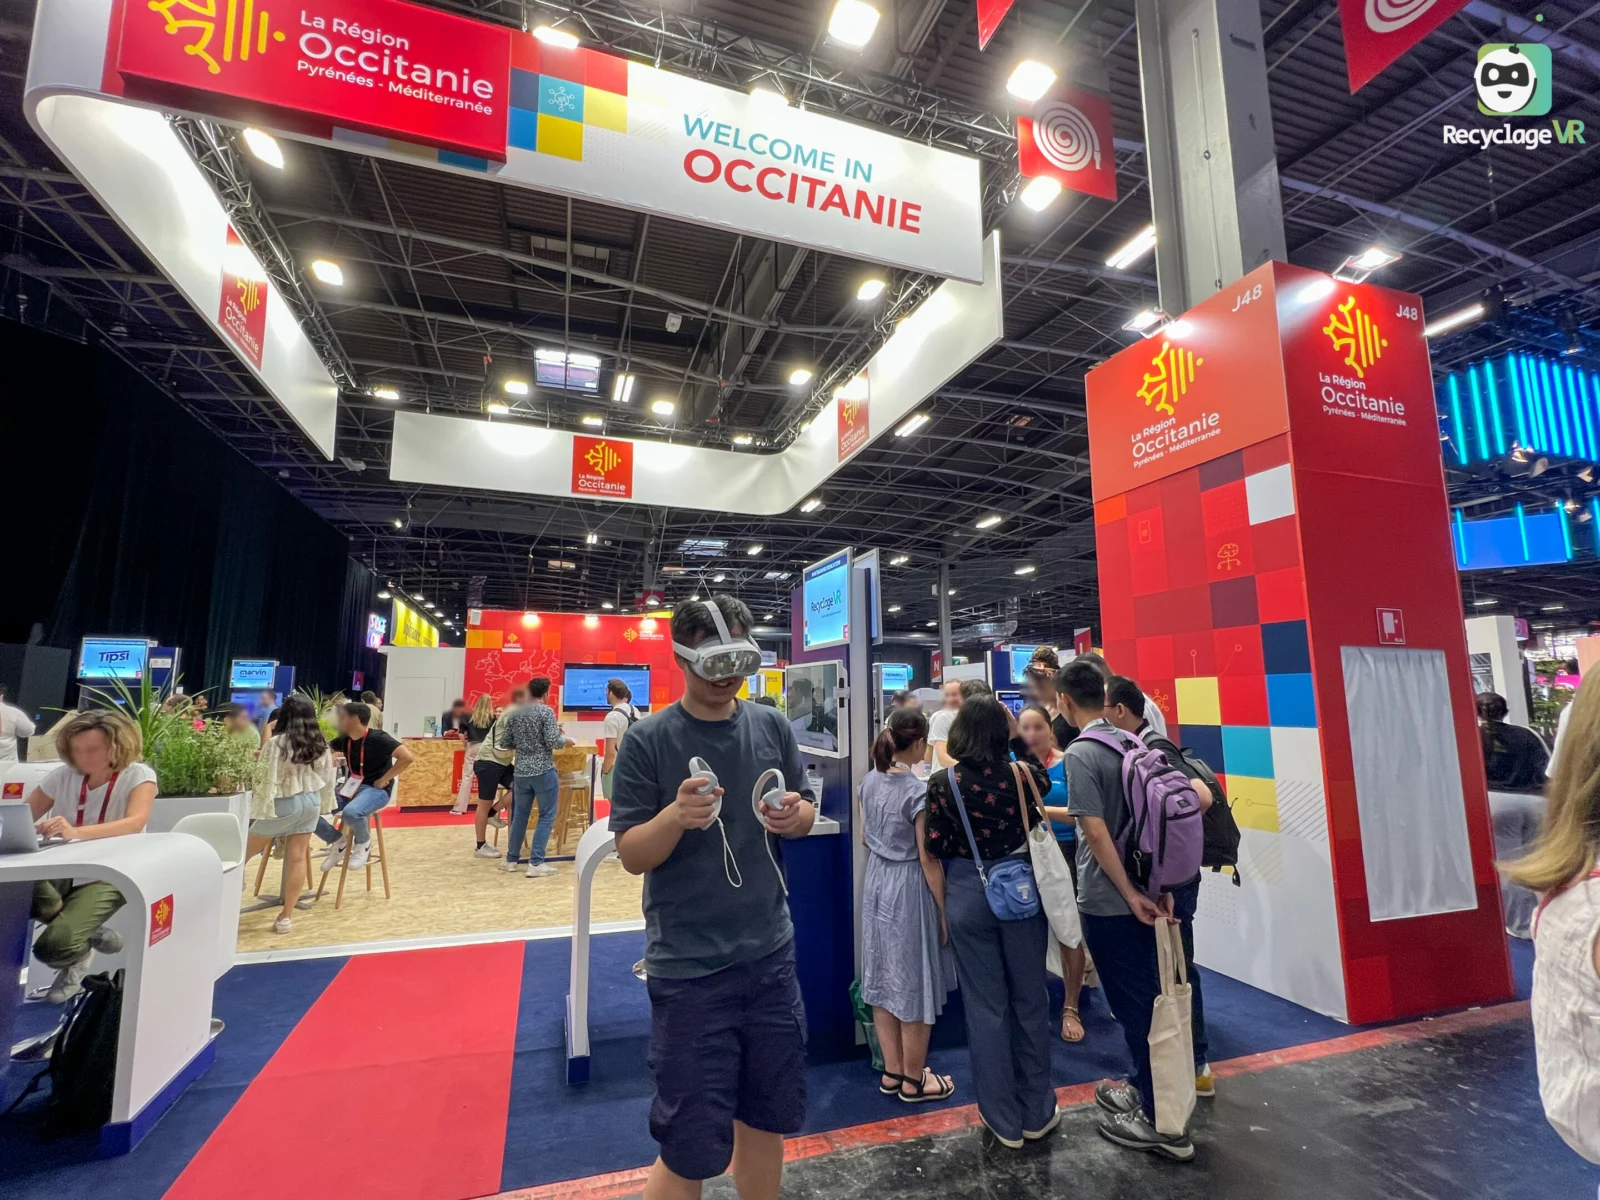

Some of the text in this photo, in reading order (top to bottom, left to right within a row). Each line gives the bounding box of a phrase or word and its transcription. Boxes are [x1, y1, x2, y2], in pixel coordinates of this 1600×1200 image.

[301, 10, 409, 50] La Région
[299, 32, 494, 99] Occitanie
[297, 60, 374, 88] Pyrénées
[388, 81, 493, 115] Méditerranée
[683, 114, 873, 183] WELCOME IN
[683, 149, 922, 234] OCCITANIE
[1232, 284, 1263, 312] J48
[1396, 305, 1418, 320] J48
[225, 306, 259, 353] Occitanie
[1319, 372, 1366, 390] La Région
[1321, 386, 1405, 415] Occitanie
[1323, 405, 1356, 418] Pyrénées
[1131, 417, 1176, 443] La Région
[1132, 412, 1220, 458] Occitanie
[1133, 451, 1164, 468] Pyrénées
[1169, 428, 1221, 453] Méditerranée
[578, 479, 626, 491] Occitanie
[833, 589, 842, 605] VR
[933, 660, 940, 671] N
